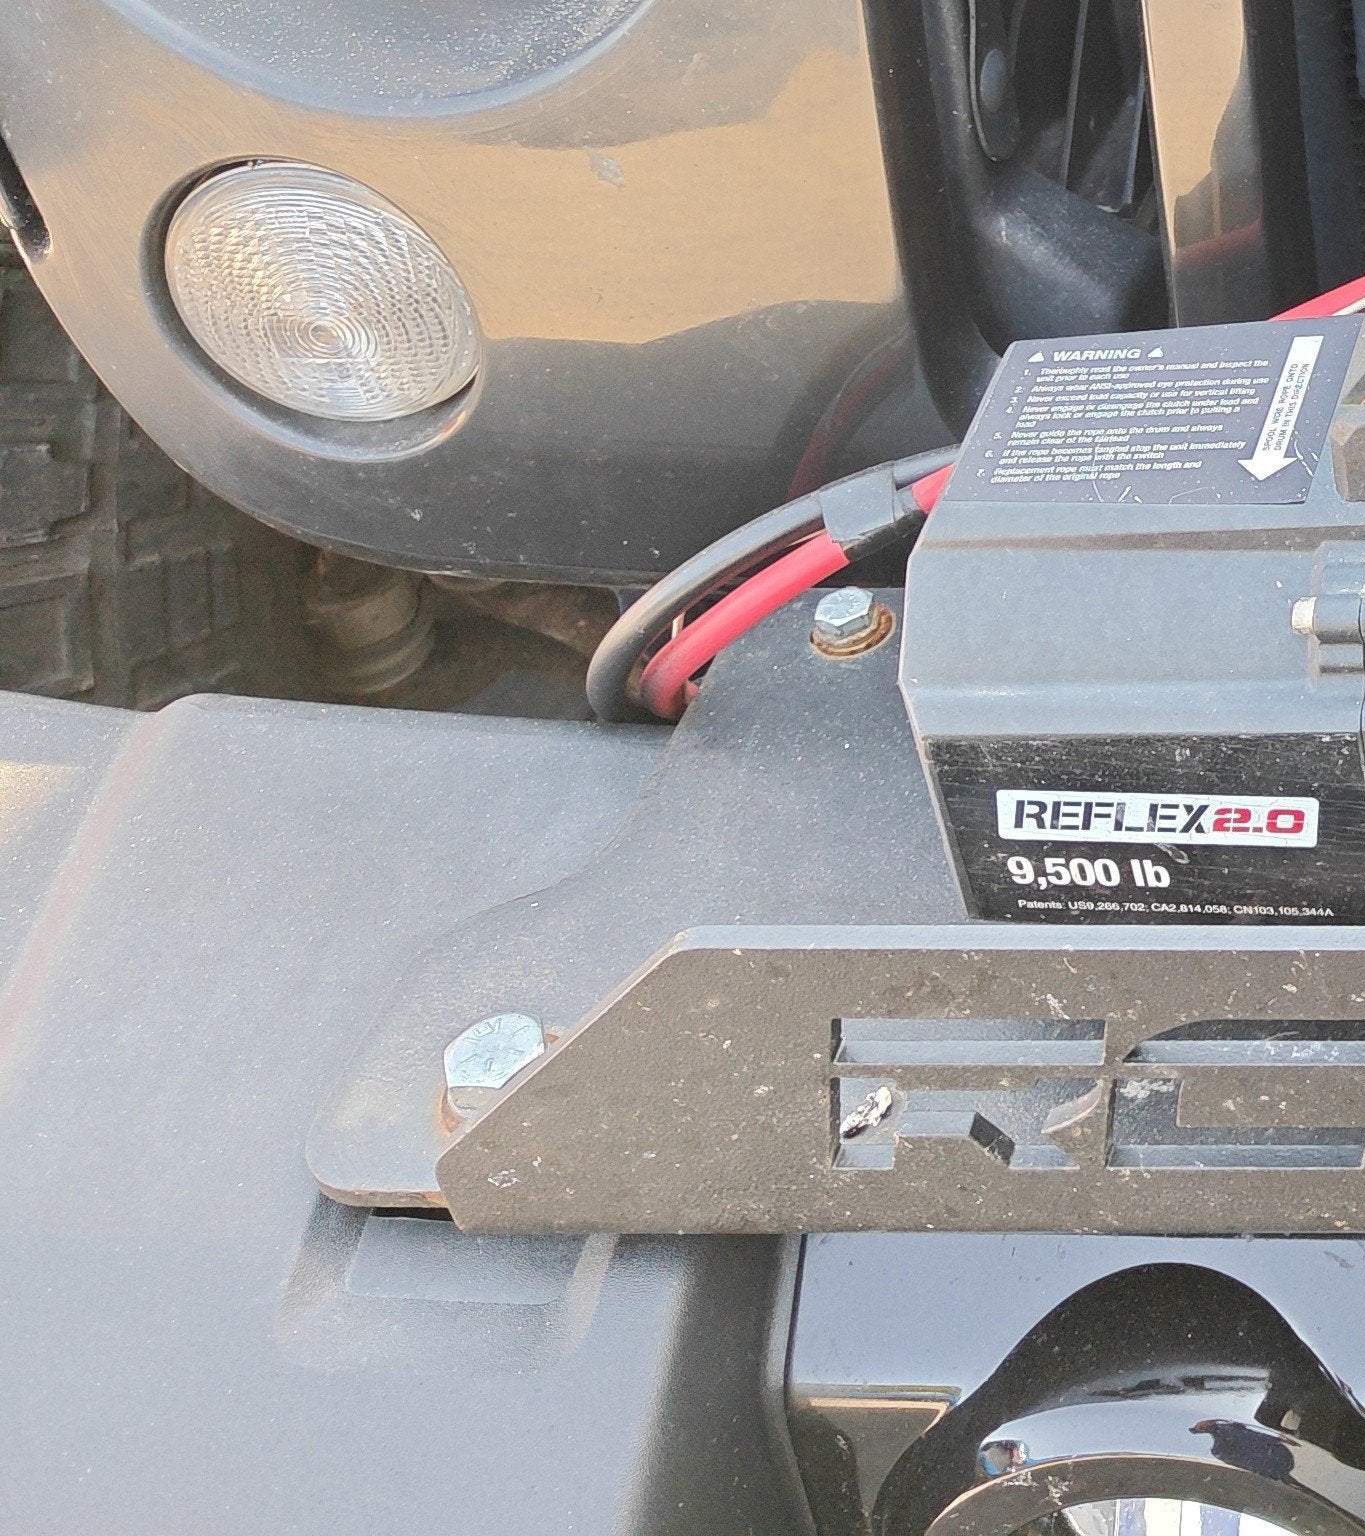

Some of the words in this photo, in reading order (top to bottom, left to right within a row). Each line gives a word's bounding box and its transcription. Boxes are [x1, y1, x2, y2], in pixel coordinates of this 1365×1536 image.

[1053, 349, 1141, 362] WARNING
[1040, 367, 1089, 375] Thoroughly
[1219, 361, 1252, 369] inspect
[1175, 379, 1220, 388] protection
[1027, 395, 1054, 403] Never
[1110, 392, 1149, 400] capacity
[1195, 388, 1228, 396] vertical
[1229, 387, 1255, 395] lifting
[1262, 428, 1277, 451] SPOOL
[1278, 385, 1291, 404] ROPE
[1286, 363, 1298, 383] ONTO
[1274, 430, 1287, 450] DRUM
[1285, 402, 1296, 418] THIS
[1291, 363, 1310, 399] DIRECTION
[1019, 413, 1051, 421] always
[1085, 410, 1118, 418] engage
[1137, 408, 1165, 416] clutch
[1166, 407, 1189, 416] prior
[1190, 407, 1199, 415] to
[1201, 406, 1232, 415] pulling
[1084, 429, 1105, 437] rope
[1191, 424, 1223, 432] always
[1130, 444, 1151, 452] stop
[1170, 442, 1188, 450] unit
[1190, 441, 1246, 449] immediately
[994, 467, 1055, 475] Replacement
[1153, 462, 1182, 470] length
[991, 475, 1033, 483] diameter
[1063, 472, 1098, 481] original
[1099, 473, 1121, 481] rope
[1013, 799, 1306, 834] REFLEX2.0
[1007, 856, 1121, 890] 9,500
[1133, 858, 1171, 888] lb
[1018, 899, 1065, 910] Patents:
